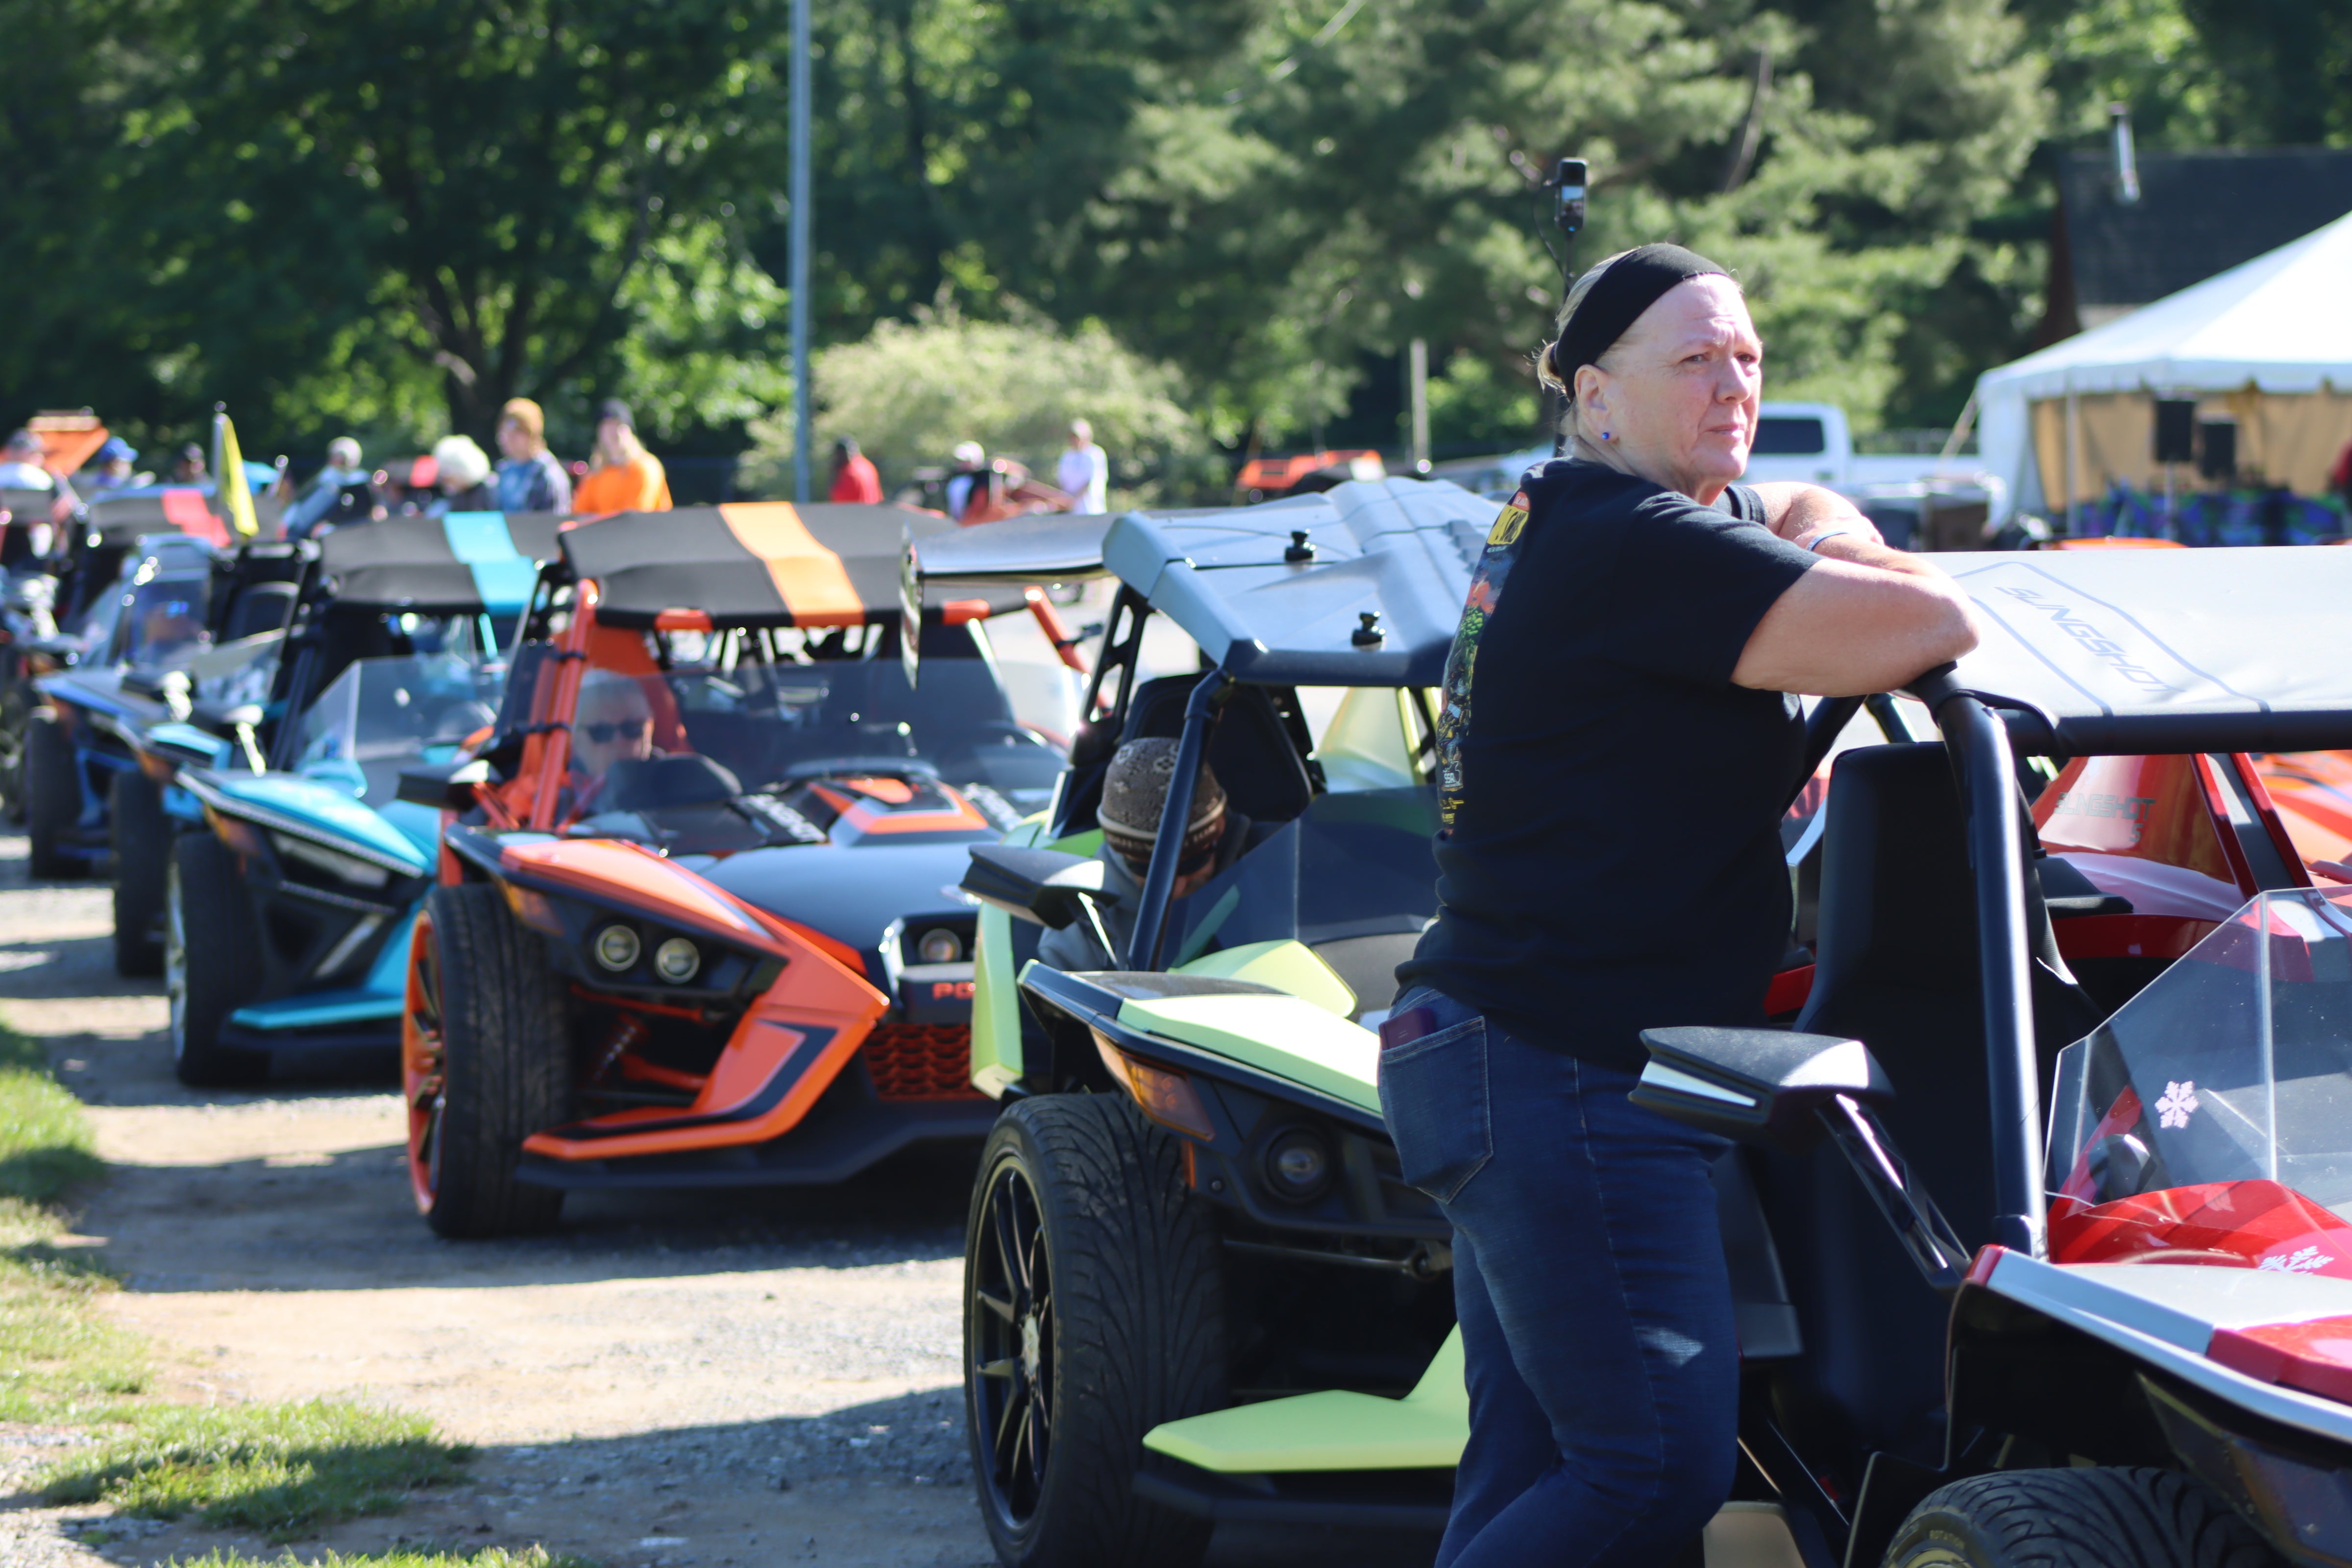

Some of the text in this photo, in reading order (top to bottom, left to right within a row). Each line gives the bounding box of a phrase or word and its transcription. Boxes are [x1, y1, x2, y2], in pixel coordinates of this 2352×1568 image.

[1993, 586, 2187, 692] SLINGSHOT
[2053, 792, 2156, 820] SLINGSHOT
[2129, 823, 2144, 842] S
